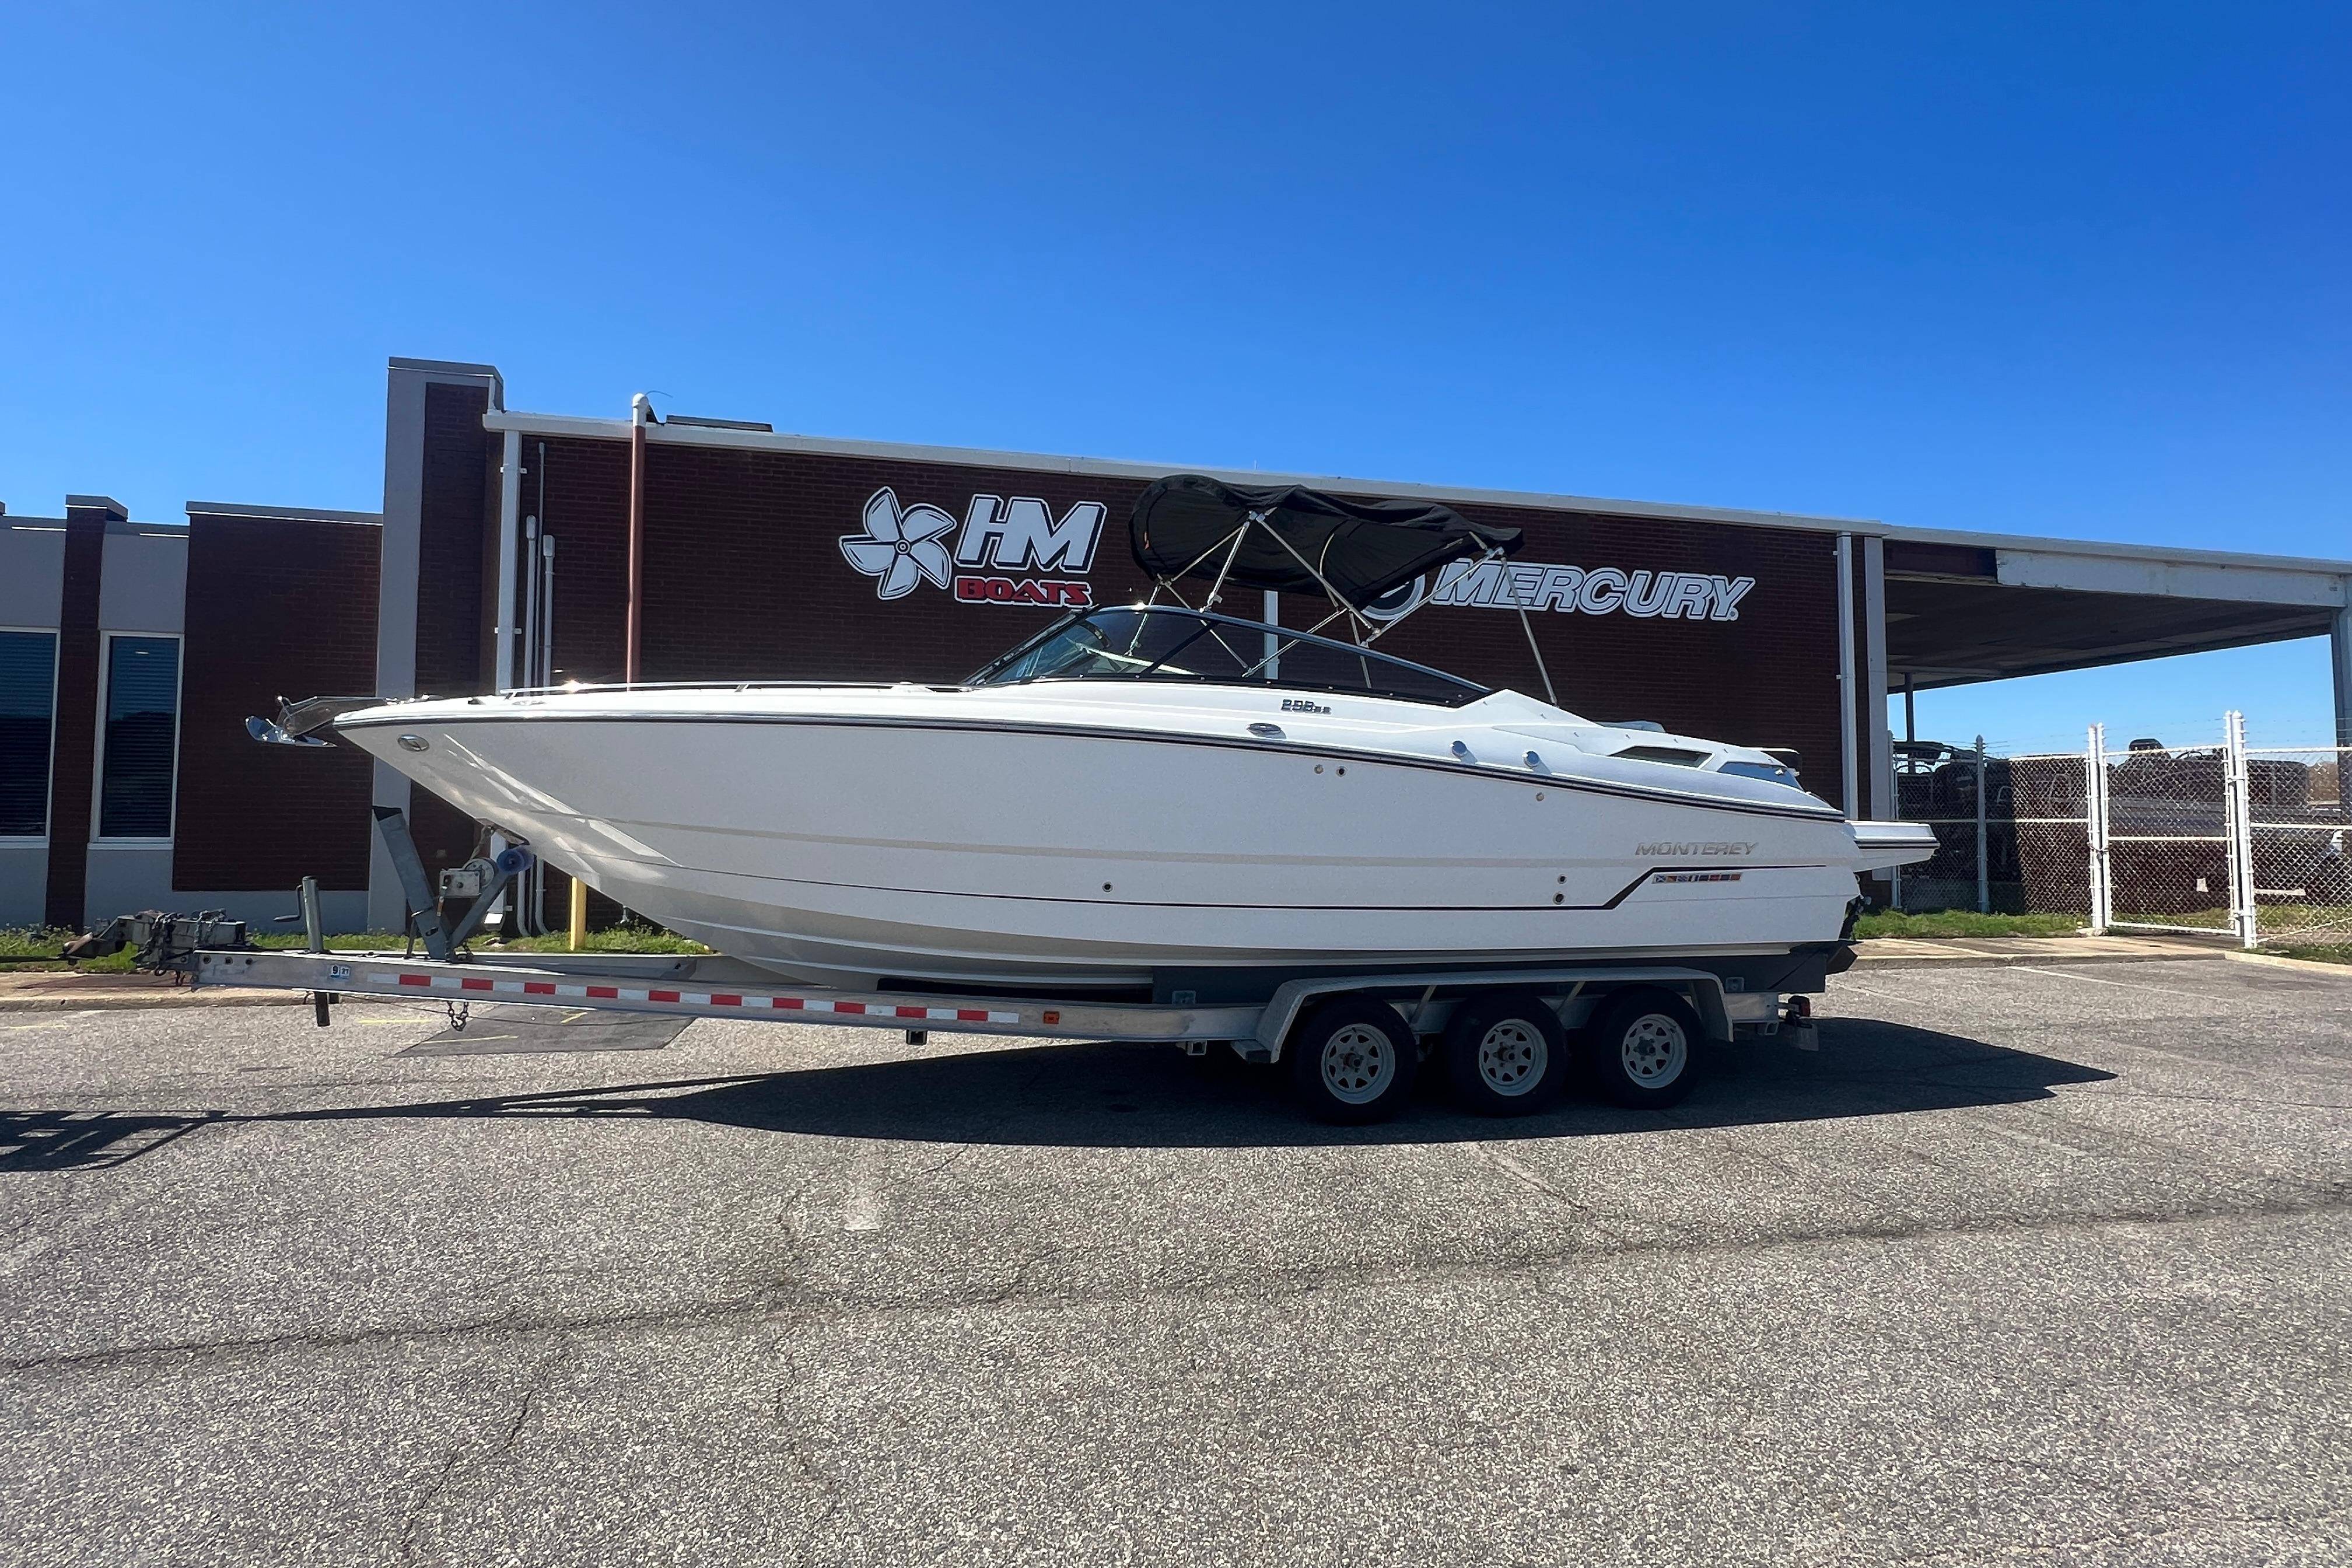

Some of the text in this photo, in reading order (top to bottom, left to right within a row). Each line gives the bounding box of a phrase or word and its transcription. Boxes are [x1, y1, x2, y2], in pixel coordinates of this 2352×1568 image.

[954, 494, 1107, 574] HM
[954, 575, 1092, 607] BOATS
[1430, 558, 1756, 621] MERCURY
[1634, 841, 1759, 856] MONTEREY
